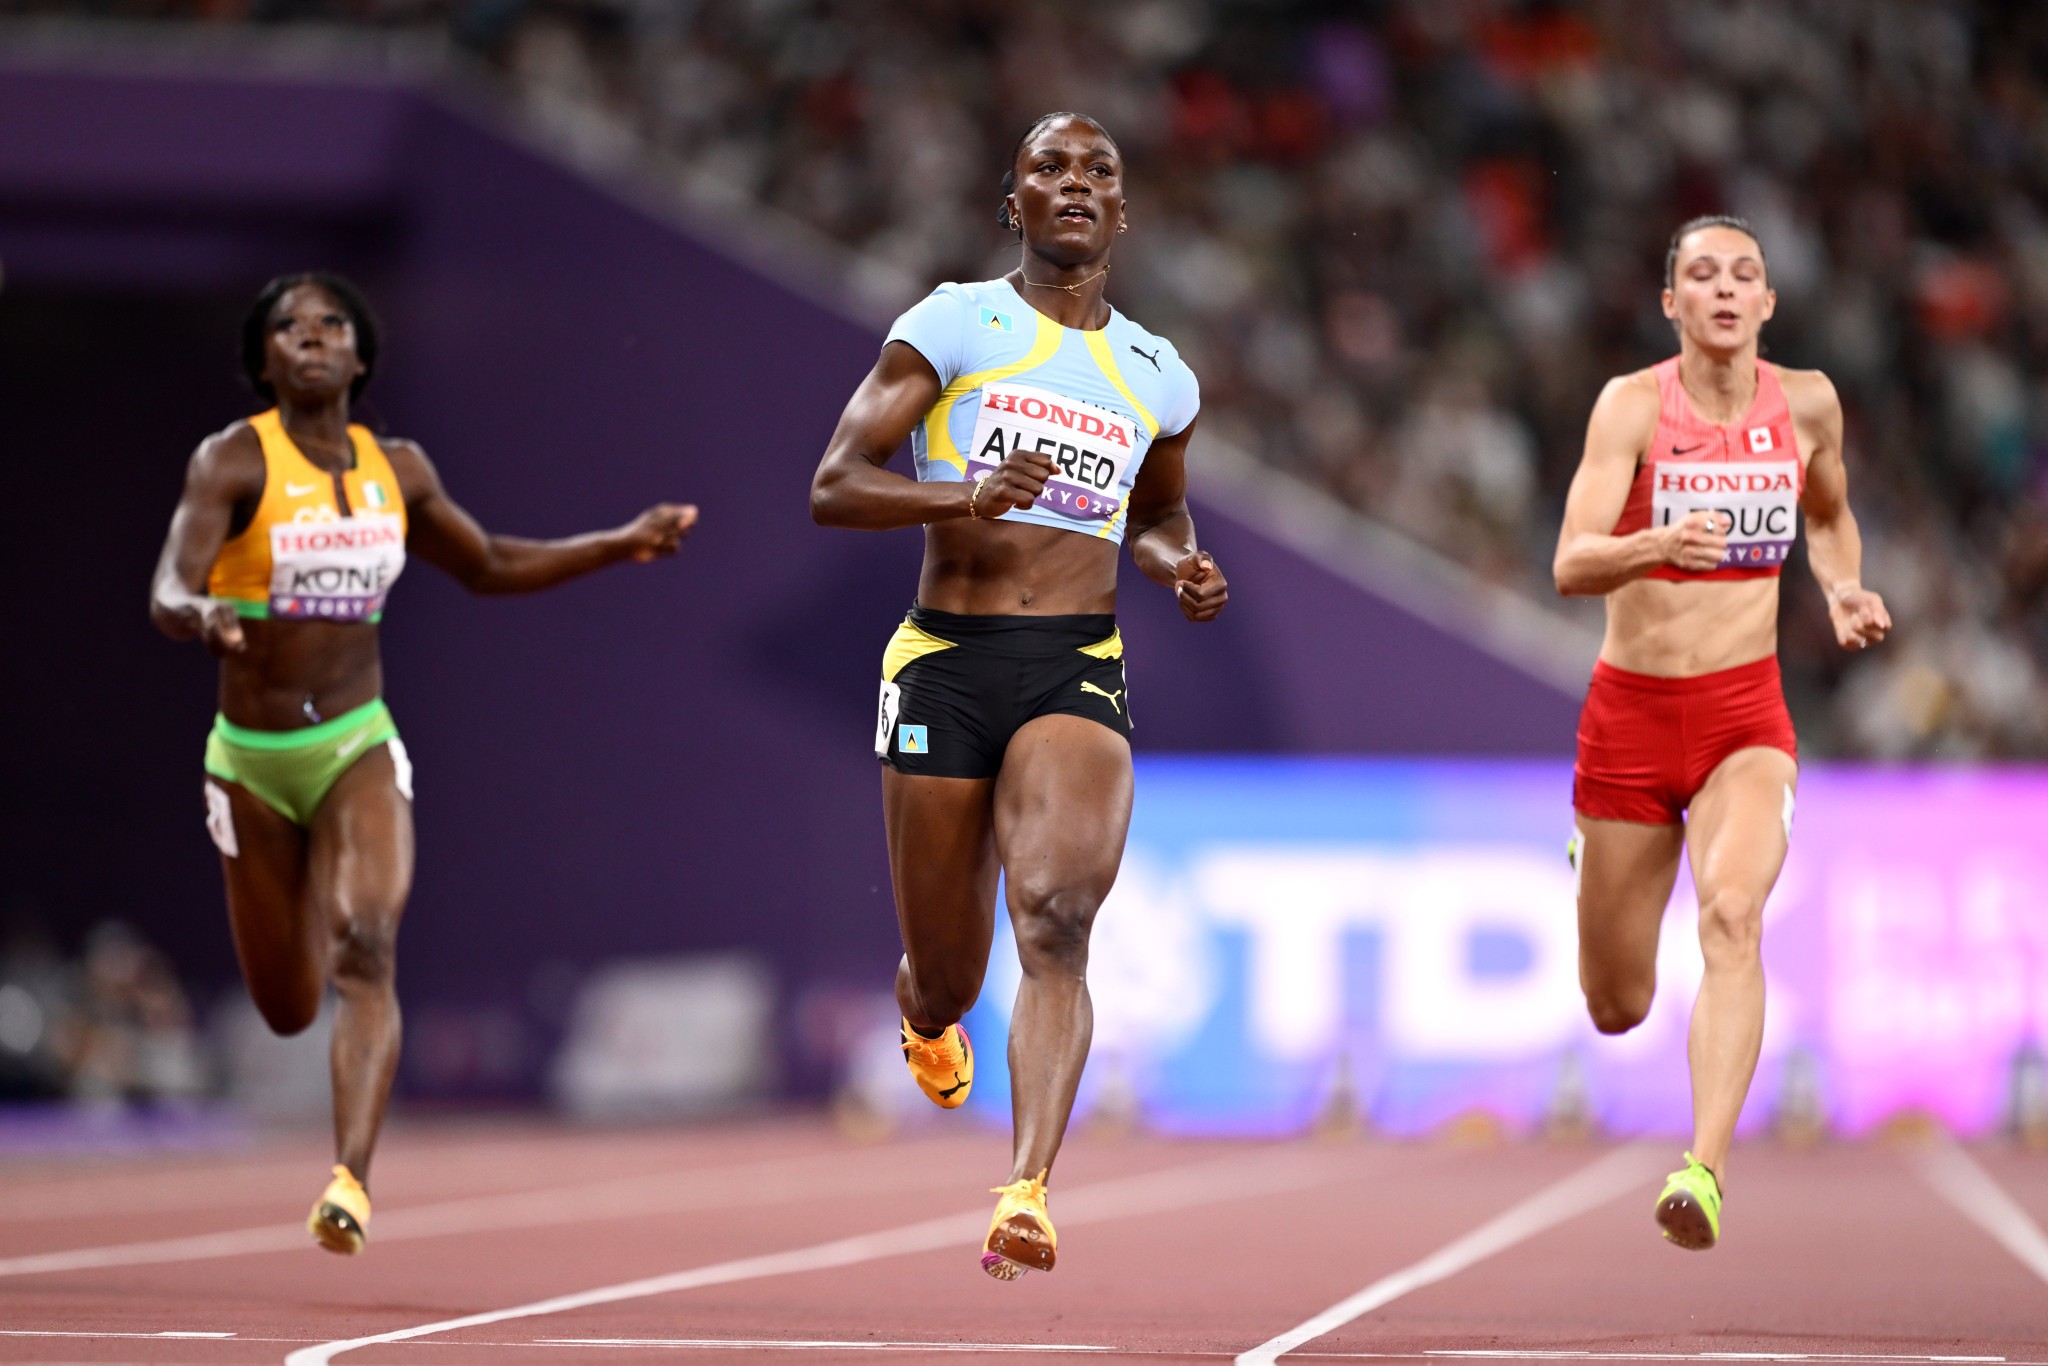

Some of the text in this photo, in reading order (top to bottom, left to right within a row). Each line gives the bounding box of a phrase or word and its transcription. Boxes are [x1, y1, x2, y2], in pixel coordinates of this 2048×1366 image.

[984, 392, 1131, 449] HONDA
[1659, 474, 1793, 493] HONDA
[1663, 506, 1788, 537] DUC
[279, 525, 396, 553] HONDA
